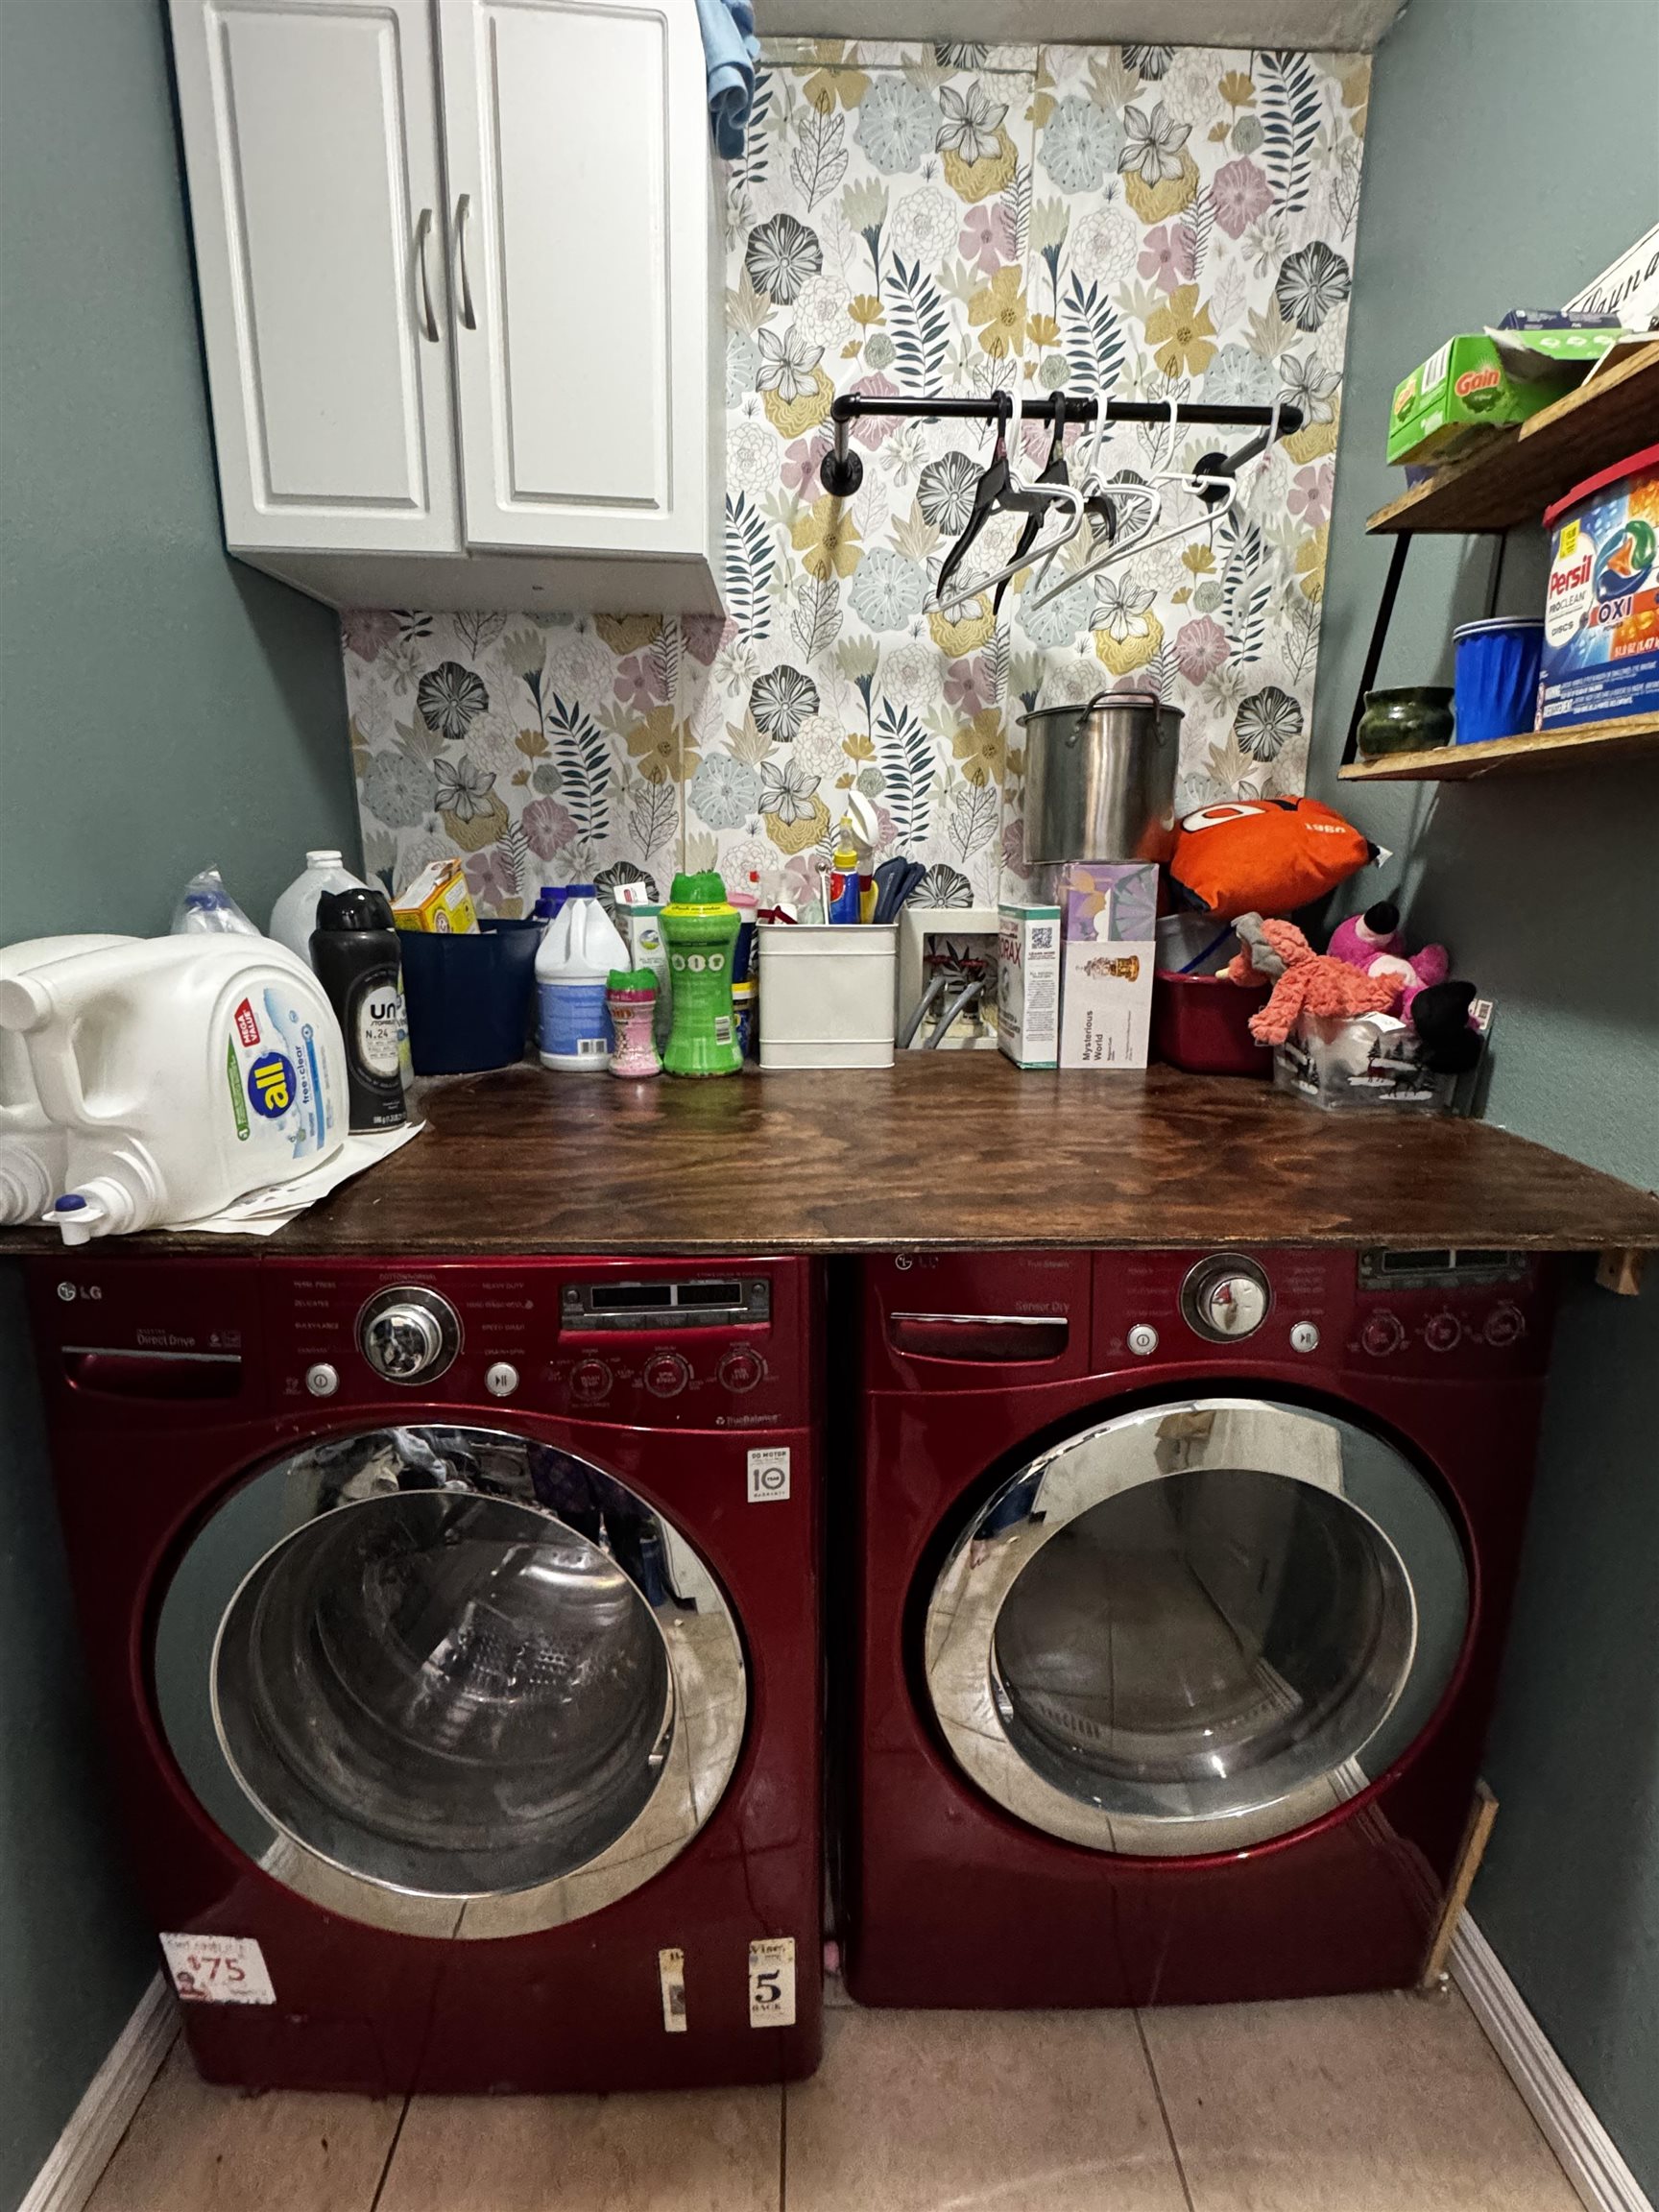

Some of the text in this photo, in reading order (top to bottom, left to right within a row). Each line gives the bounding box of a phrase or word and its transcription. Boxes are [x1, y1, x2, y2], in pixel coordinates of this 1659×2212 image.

[1455, 370, 1501, 397] Gain
[1551, 556, 1592, 597] Persil
[1599, 596, 1632, 622] OXI
[238, 1015, 251, 1044] MEGA
[244, 1011, 256, 1042] VALUE
[1082, 1010, 1094, 1061] Mysterious
[1094, 1034, 1103, 1061] World
[254, 1062, 289, 1111] all
[80, 1286, 102, 1299] LG
[755, 1969, 781, 2004] 5
